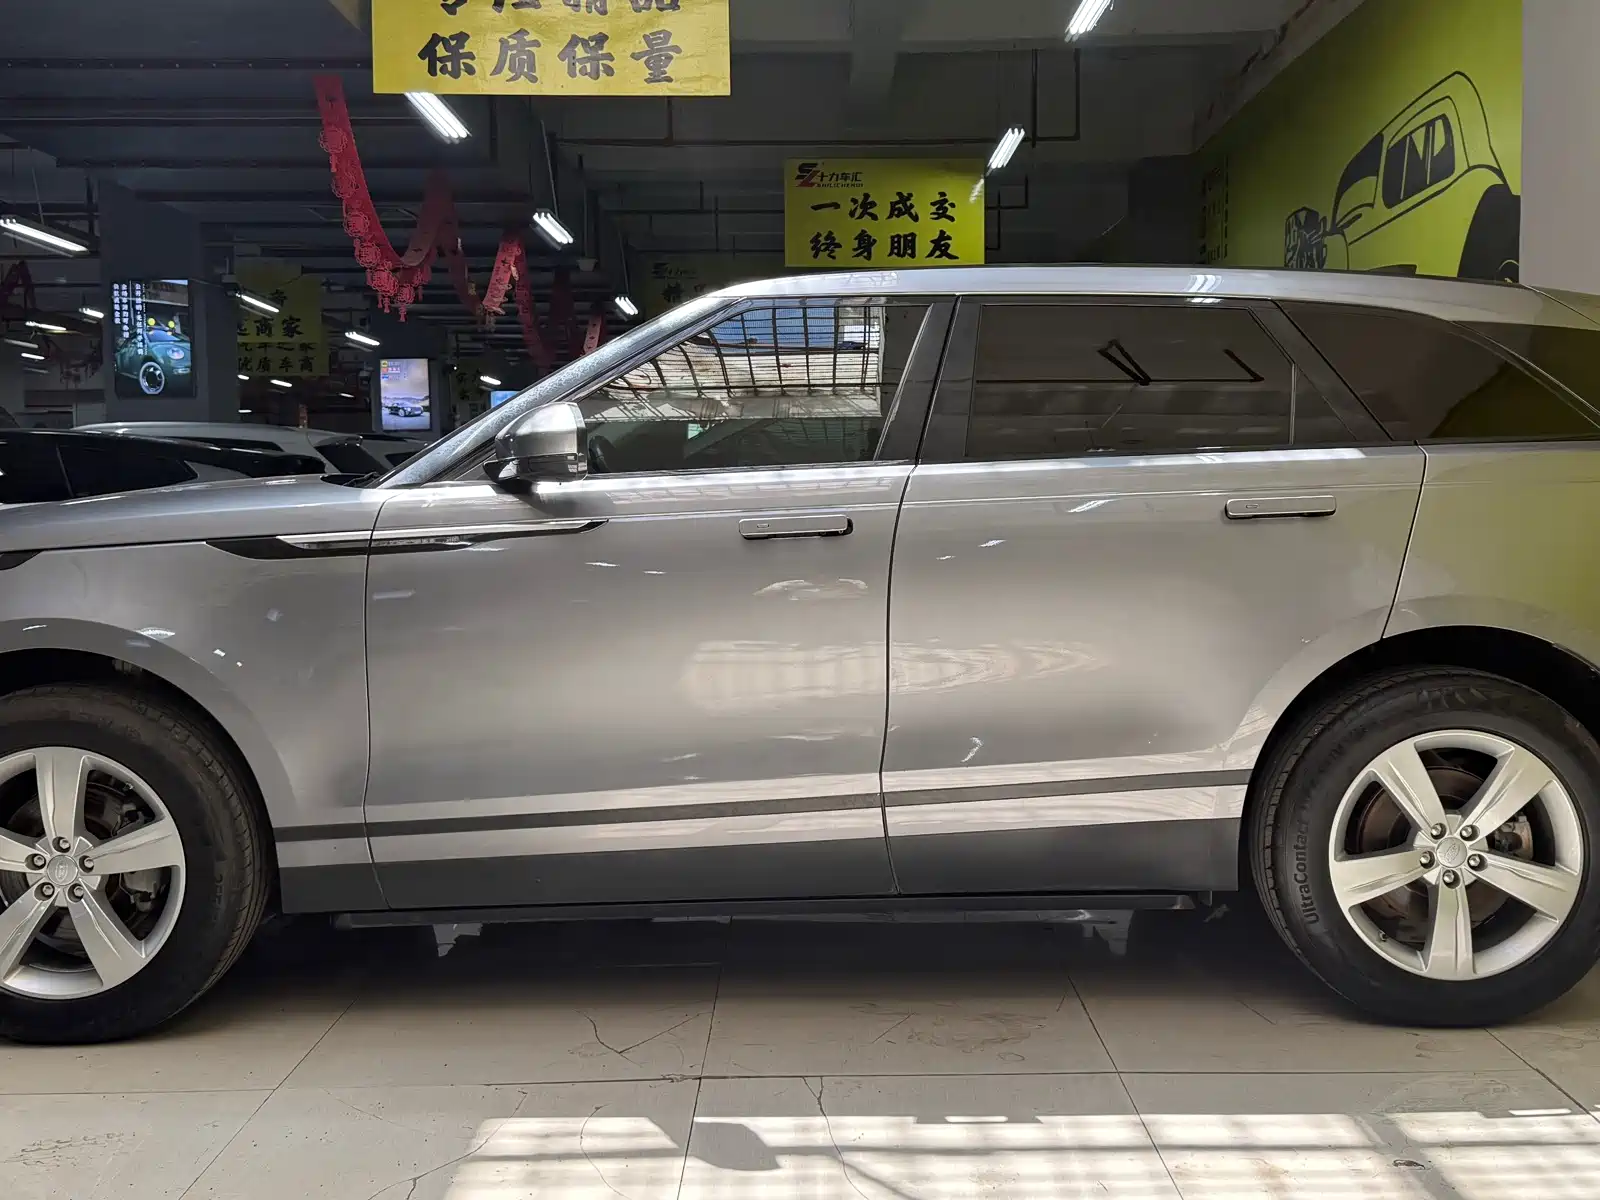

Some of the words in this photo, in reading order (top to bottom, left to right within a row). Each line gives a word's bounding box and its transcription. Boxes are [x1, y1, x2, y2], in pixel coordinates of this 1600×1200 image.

[418, 28, 683, 84] 保质保量
[811, 192, 956, 222] 一次成交
[809, 229, 960, 261] 终身朋友
